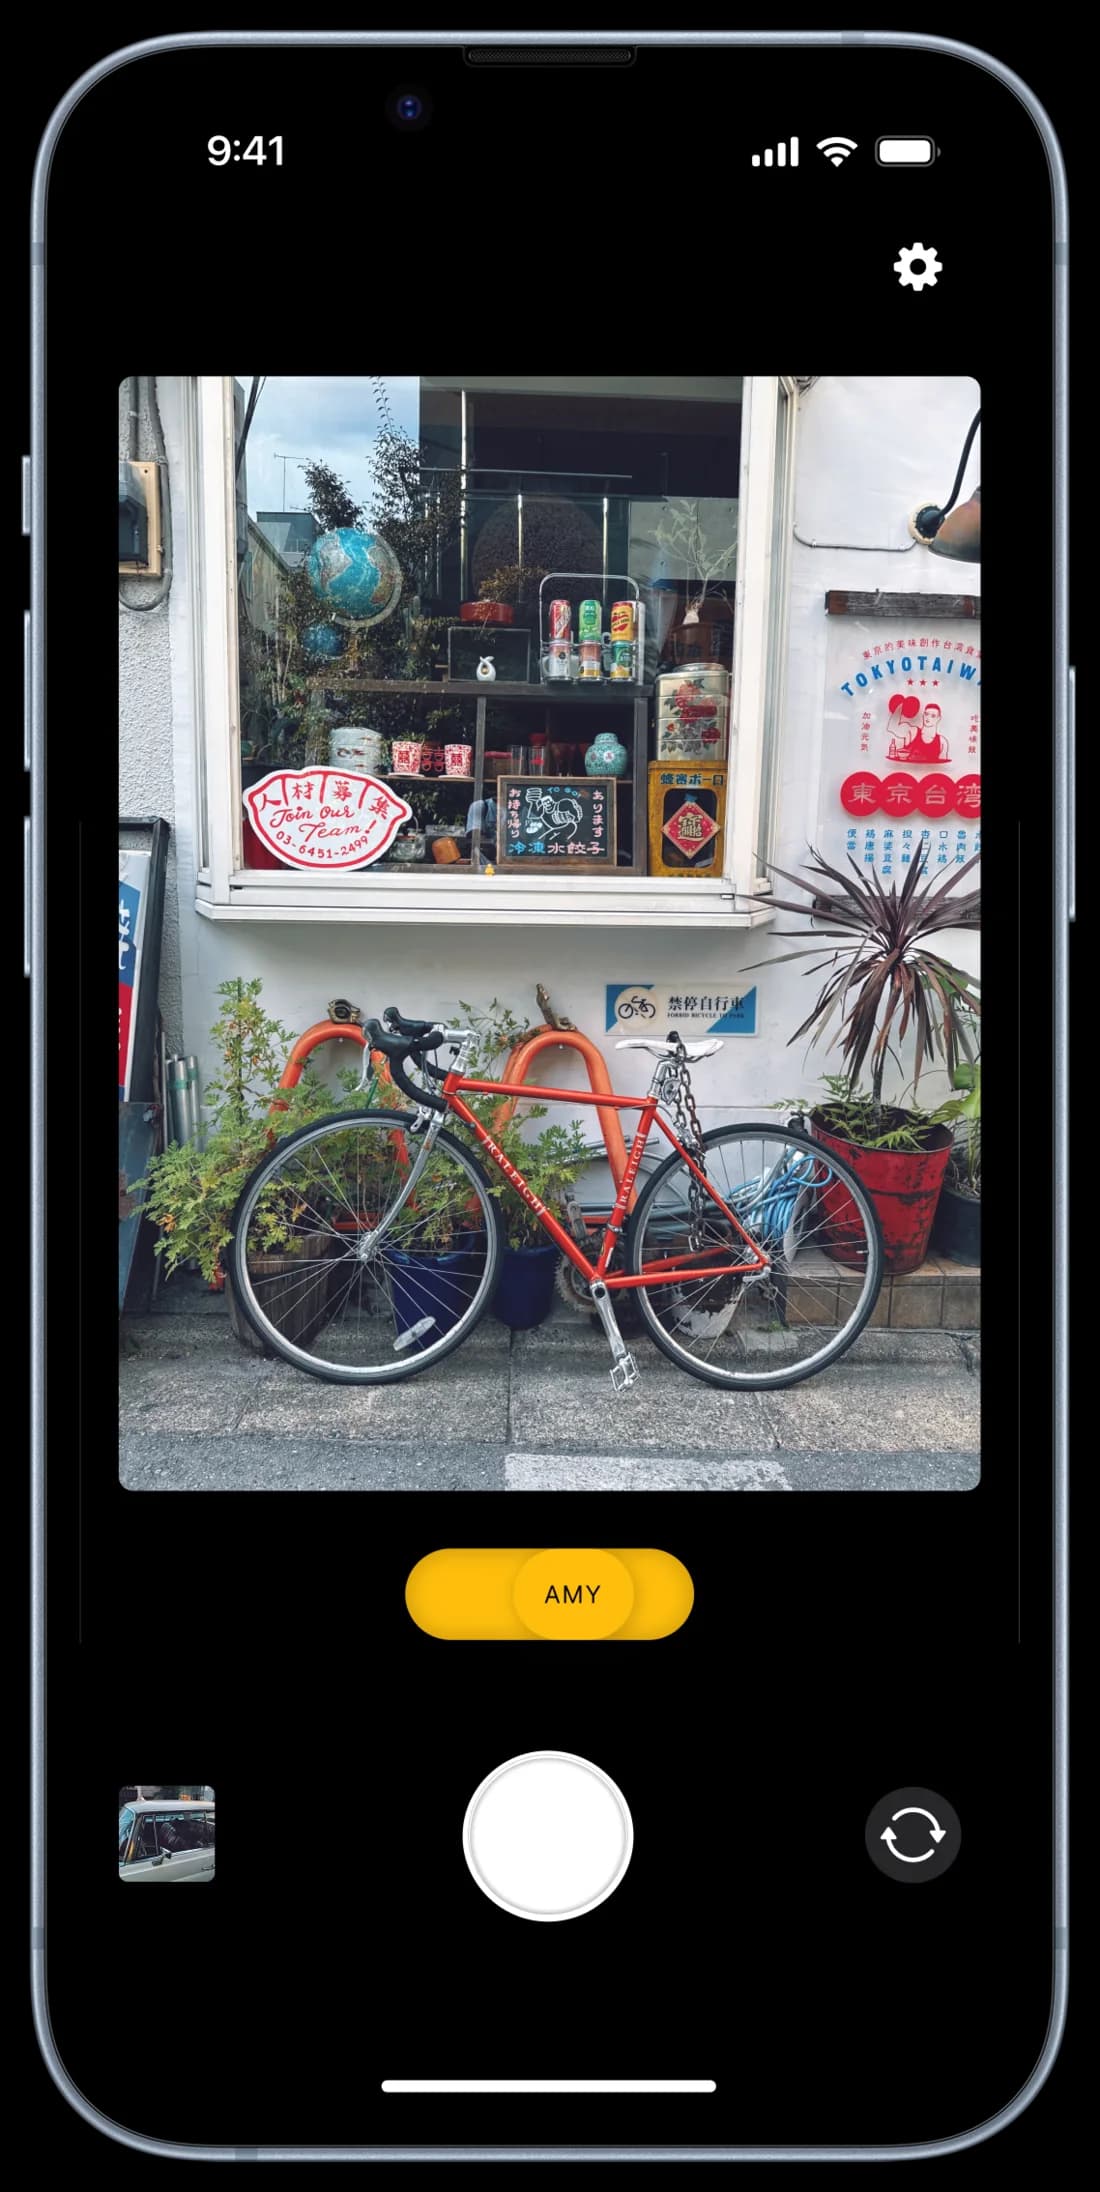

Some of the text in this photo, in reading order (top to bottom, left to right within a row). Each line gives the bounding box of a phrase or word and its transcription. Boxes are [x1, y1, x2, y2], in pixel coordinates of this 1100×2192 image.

[207, 135, 283, 166] 9:41
[259, 781, 390, 820] 人材募集
[507, 788, 521, 838] お持ち帰り
[592, 790, 605, 838] あります
[269, 805, 356, 828] Join Our
[276, 830, 369, 859] 03-6451-2499
[508, 841, 605, 854] 冷凍水餃子
[668, 996, 744, 1011] 禁停自行車
[487, 1141, 545, 1212] RALEIGH
[619, 1138, 646, 1204] RALEIGH
[545, 1585, 600, 1604] AMY
